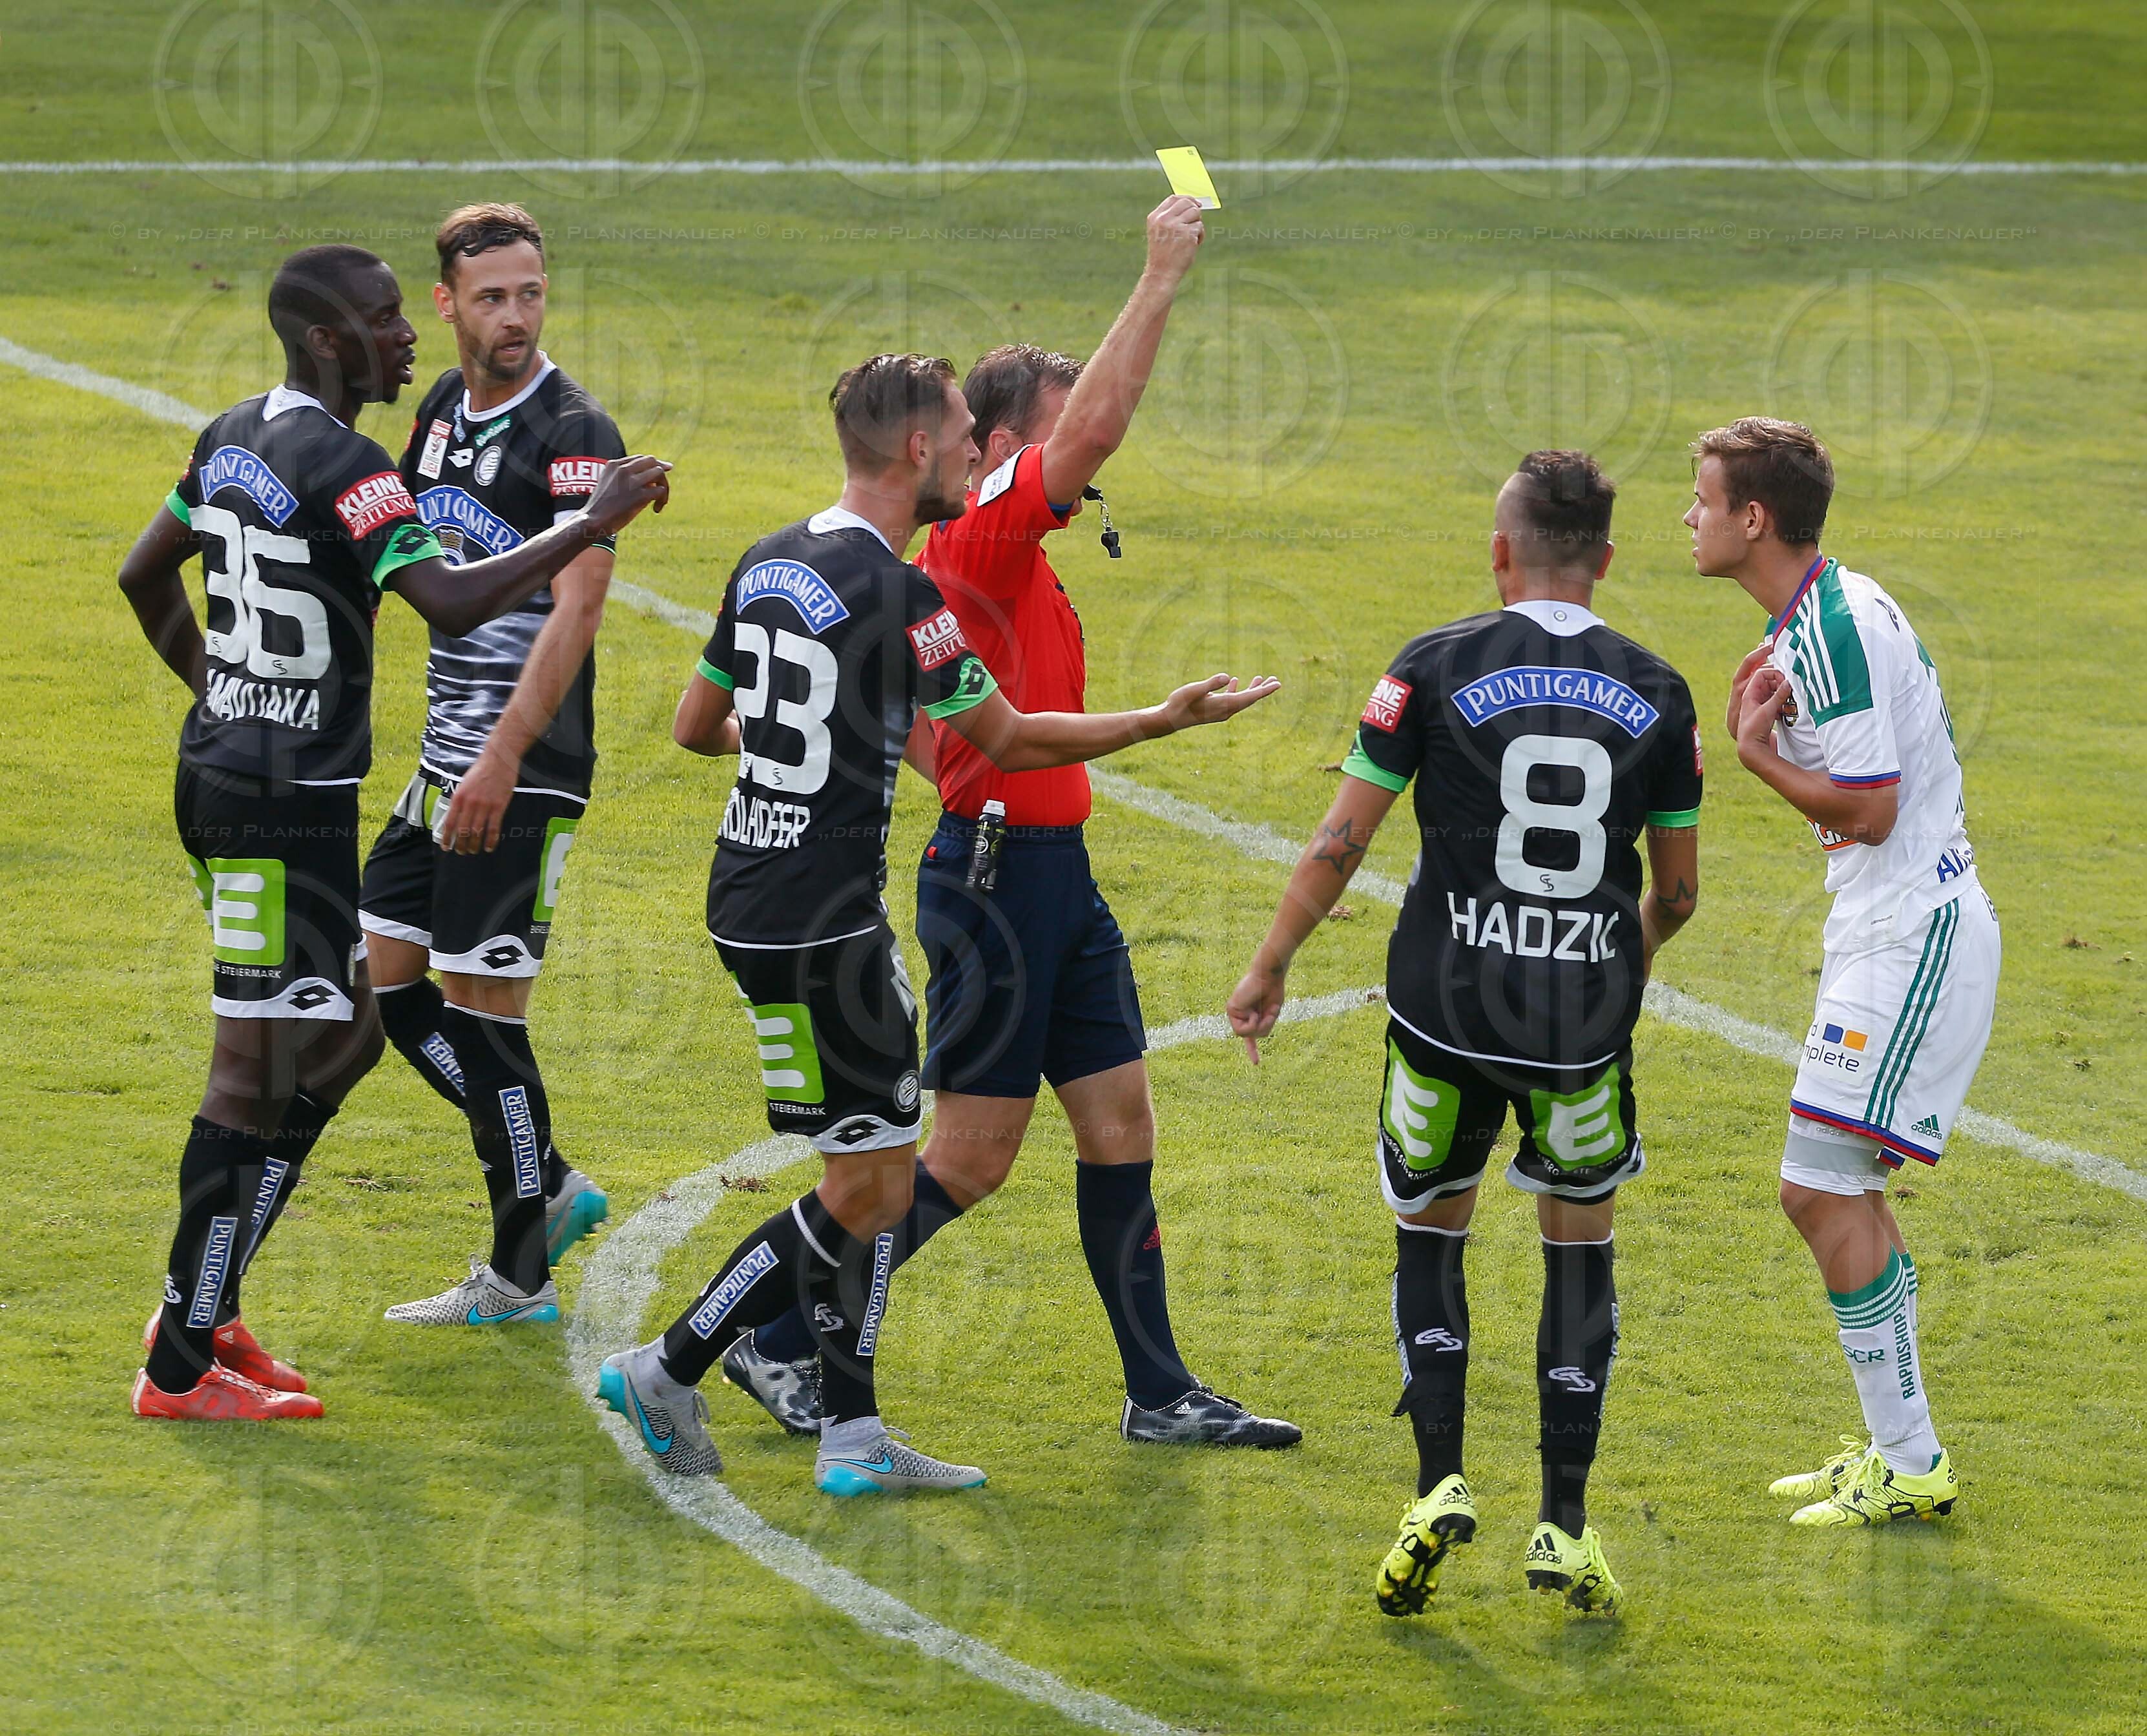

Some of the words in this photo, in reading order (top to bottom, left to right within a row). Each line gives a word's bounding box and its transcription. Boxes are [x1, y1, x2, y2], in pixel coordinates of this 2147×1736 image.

[740, 566, 837, 625] PUNTIGAMER
[732, 622, 838, 795] 23
[1464, 674, 1648, 729] PUNTIGAMER
[1494, 734, 1612, 899] 8
[1911, 1123, 1943, 1140] adidas
[193, 1223, 233, 1323] PUNTIGAMER
[694, 1249, 771, 1337] PUNTIGAMER
[1842, 1344, 1885, 1363] SCR
